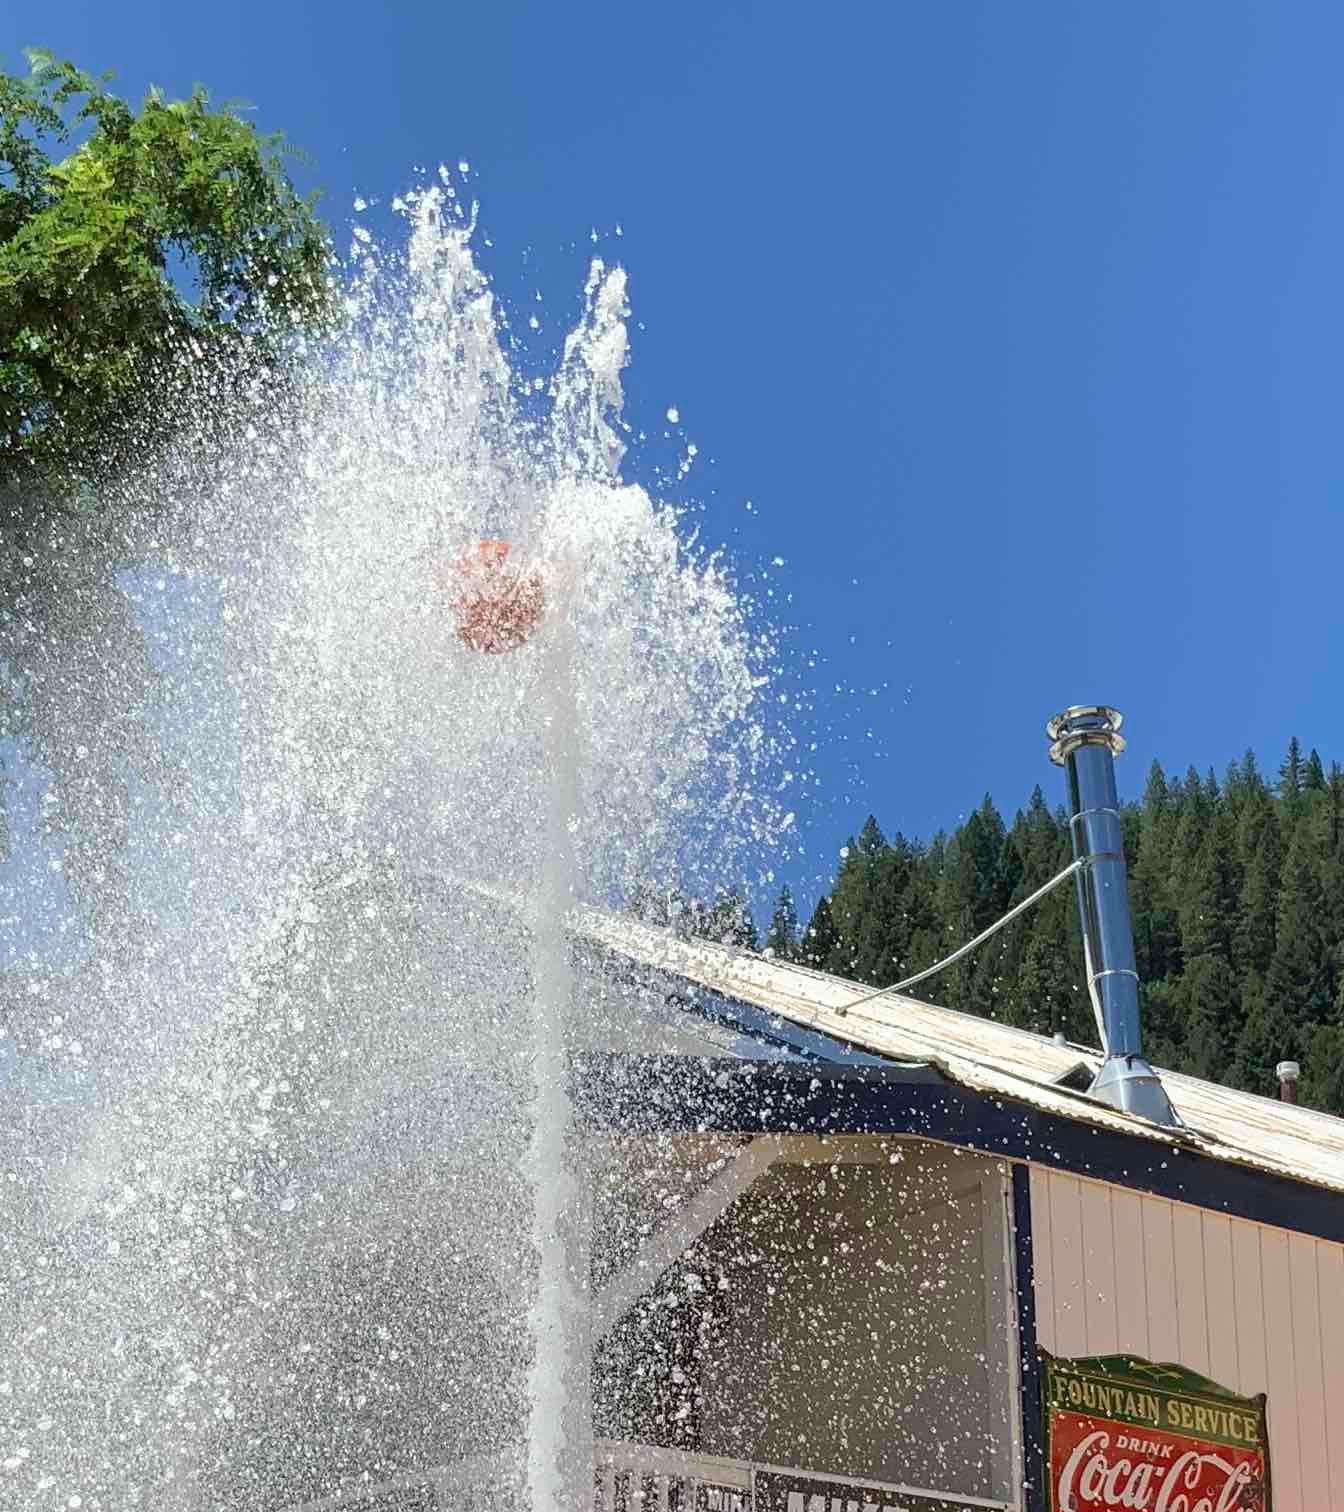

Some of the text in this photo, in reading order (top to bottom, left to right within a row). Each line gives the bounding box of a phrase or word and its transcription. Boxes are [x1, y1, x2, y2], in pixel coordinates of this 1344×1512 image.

[1057, 1375, 1259, 1441] FOUNTAIN SERVICE
[1116, 1434, 1175, 1459] DRINK
